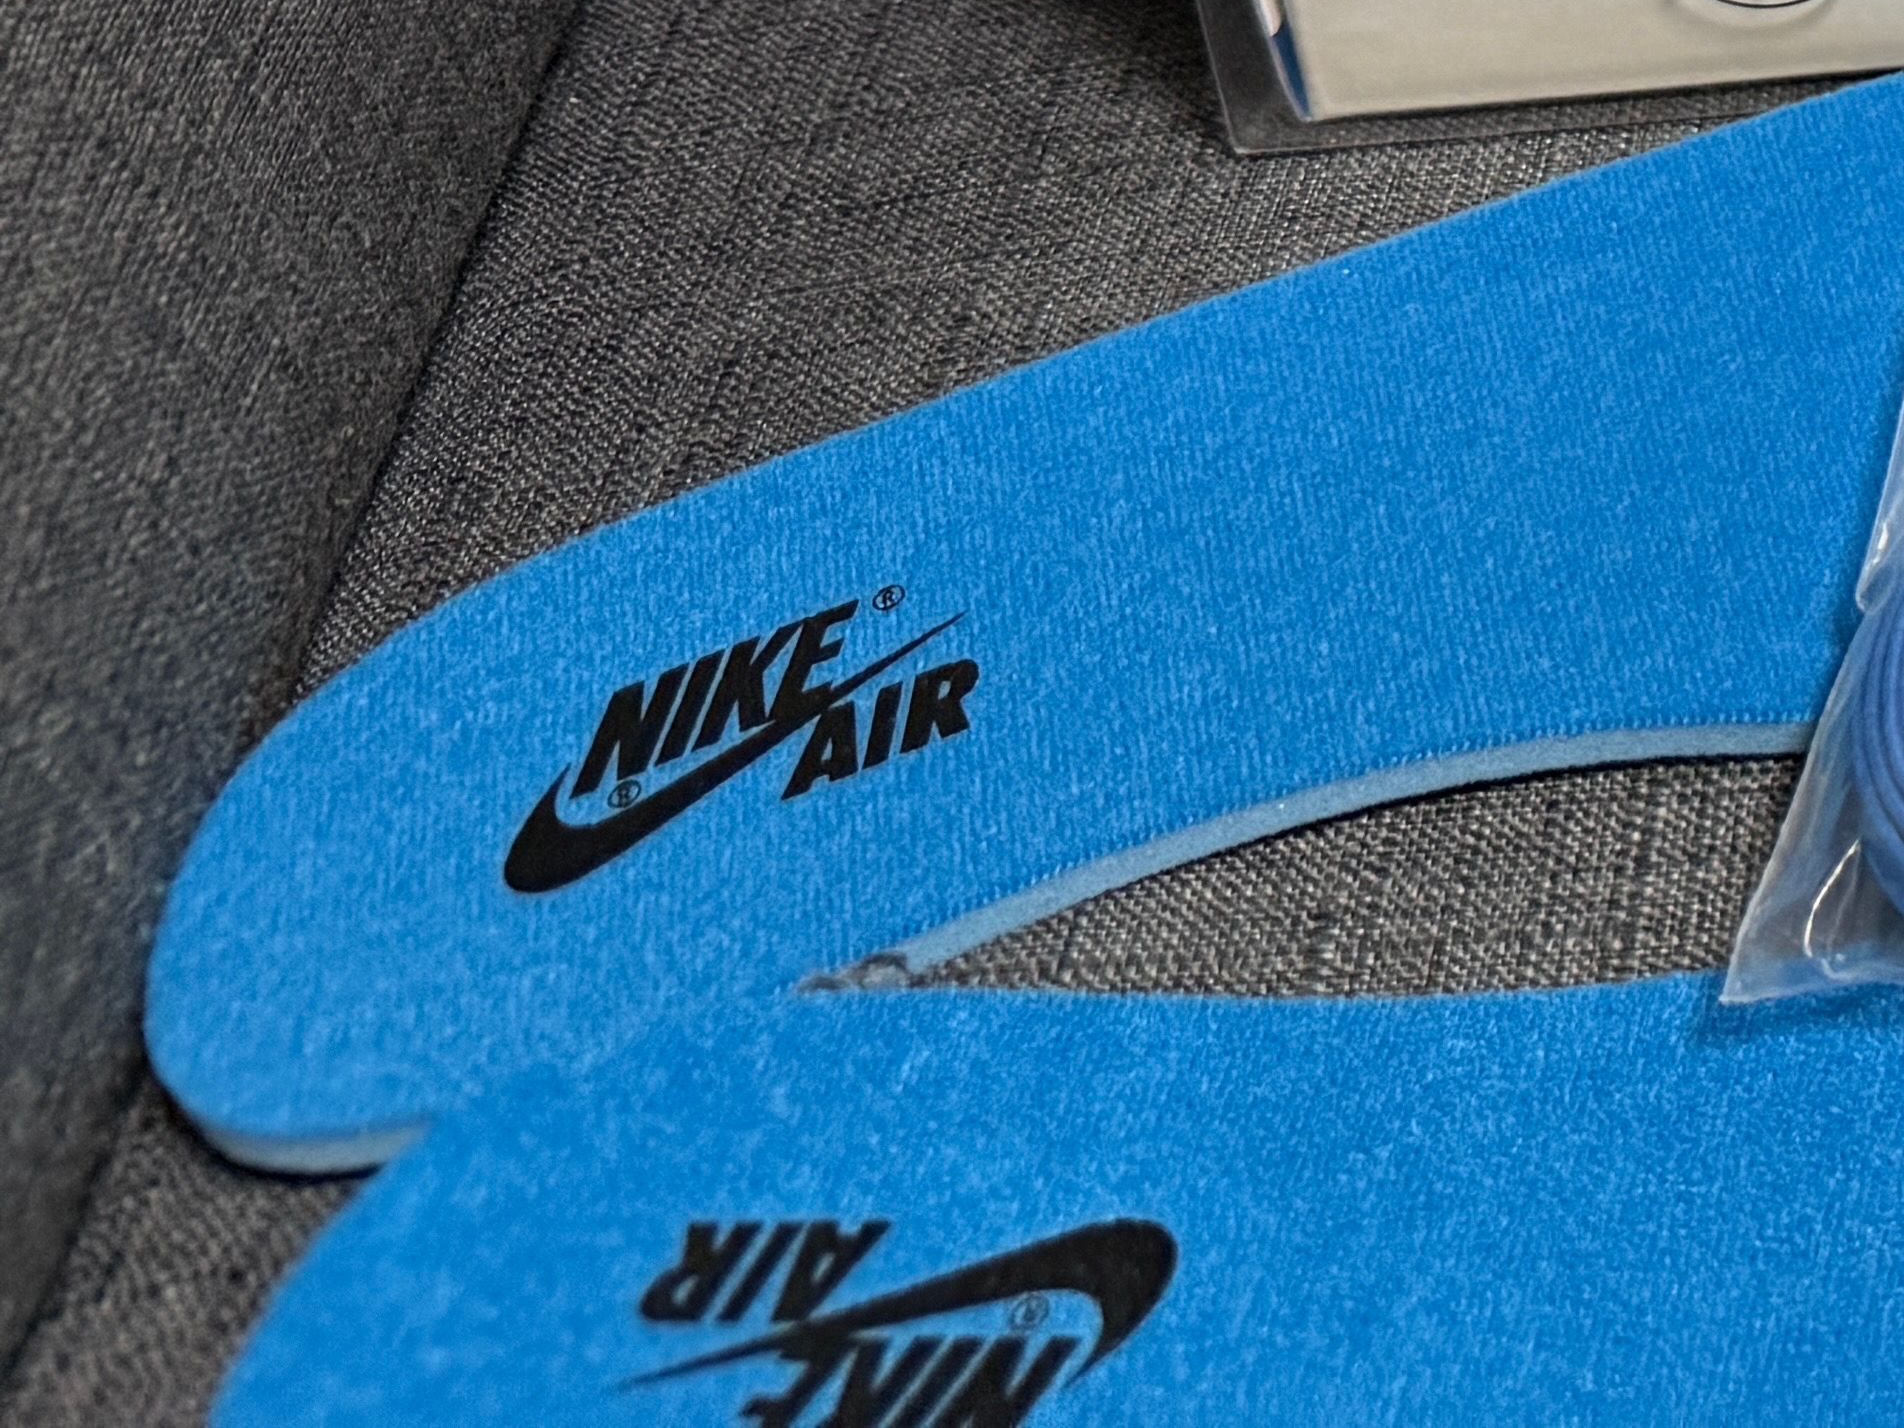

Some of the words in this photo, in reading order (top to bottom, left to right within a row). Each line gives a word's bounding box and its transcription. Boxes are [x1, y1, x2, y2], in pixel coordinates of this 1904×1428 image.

[569, 598, 860, 801] NIKE
[780, 658, 980, 801] AIR
[638, 1219, 892, 1323] AIR
